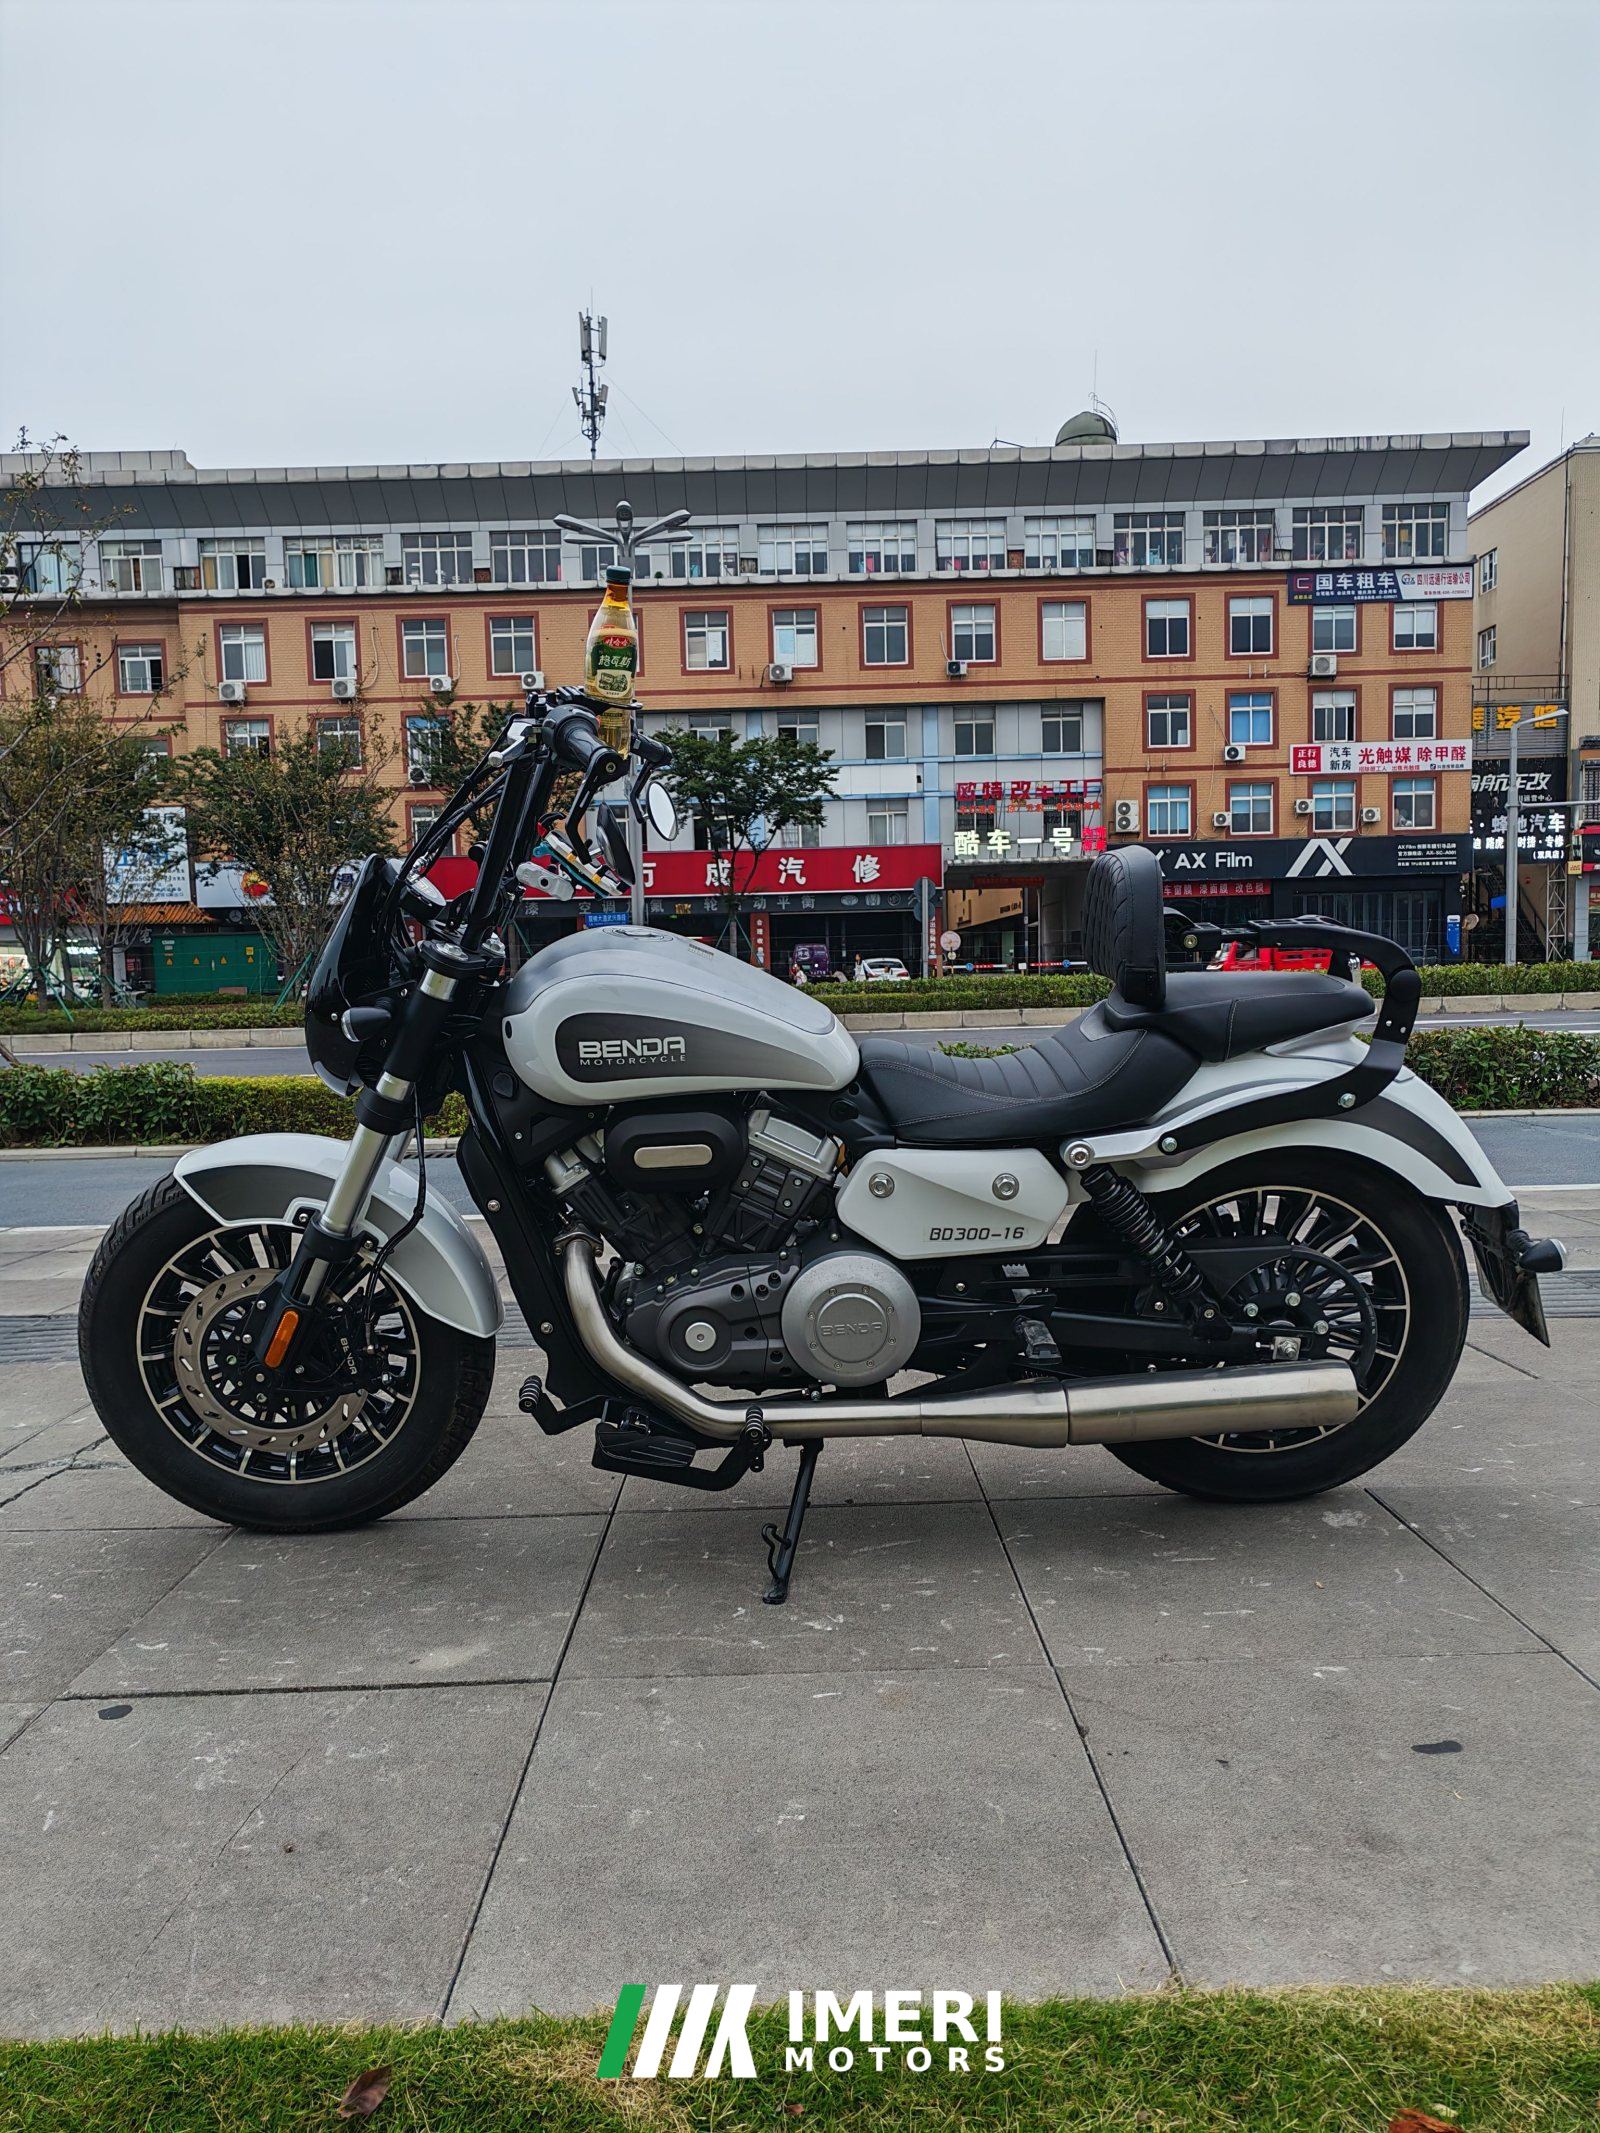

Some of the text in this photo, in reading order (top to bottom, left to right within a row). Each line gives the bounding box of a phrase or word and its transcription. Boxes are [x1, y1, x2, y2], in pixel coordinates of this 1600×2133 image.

[1315, 571, 1395, 591] 国车租车
[598, 655, 633, 668] 格瓦斯
[1329, 747, 1352, 758] 汽车
[1358, 745, 1467, 765] 光触媒 除甲醛
[1329, 760, 1352, 771] 新房
[953, 828, 1075, 856] 酷车一号
[1174, 852, 1253, 869] AX Film
[578, 1036, 686, 1059] BENDA
[579, 1054, 686, 1066] MOTORCYCLE
[929, 1226, 1025, 1241] BD300-16
[820, 1321, 883, 1336] BENDA
